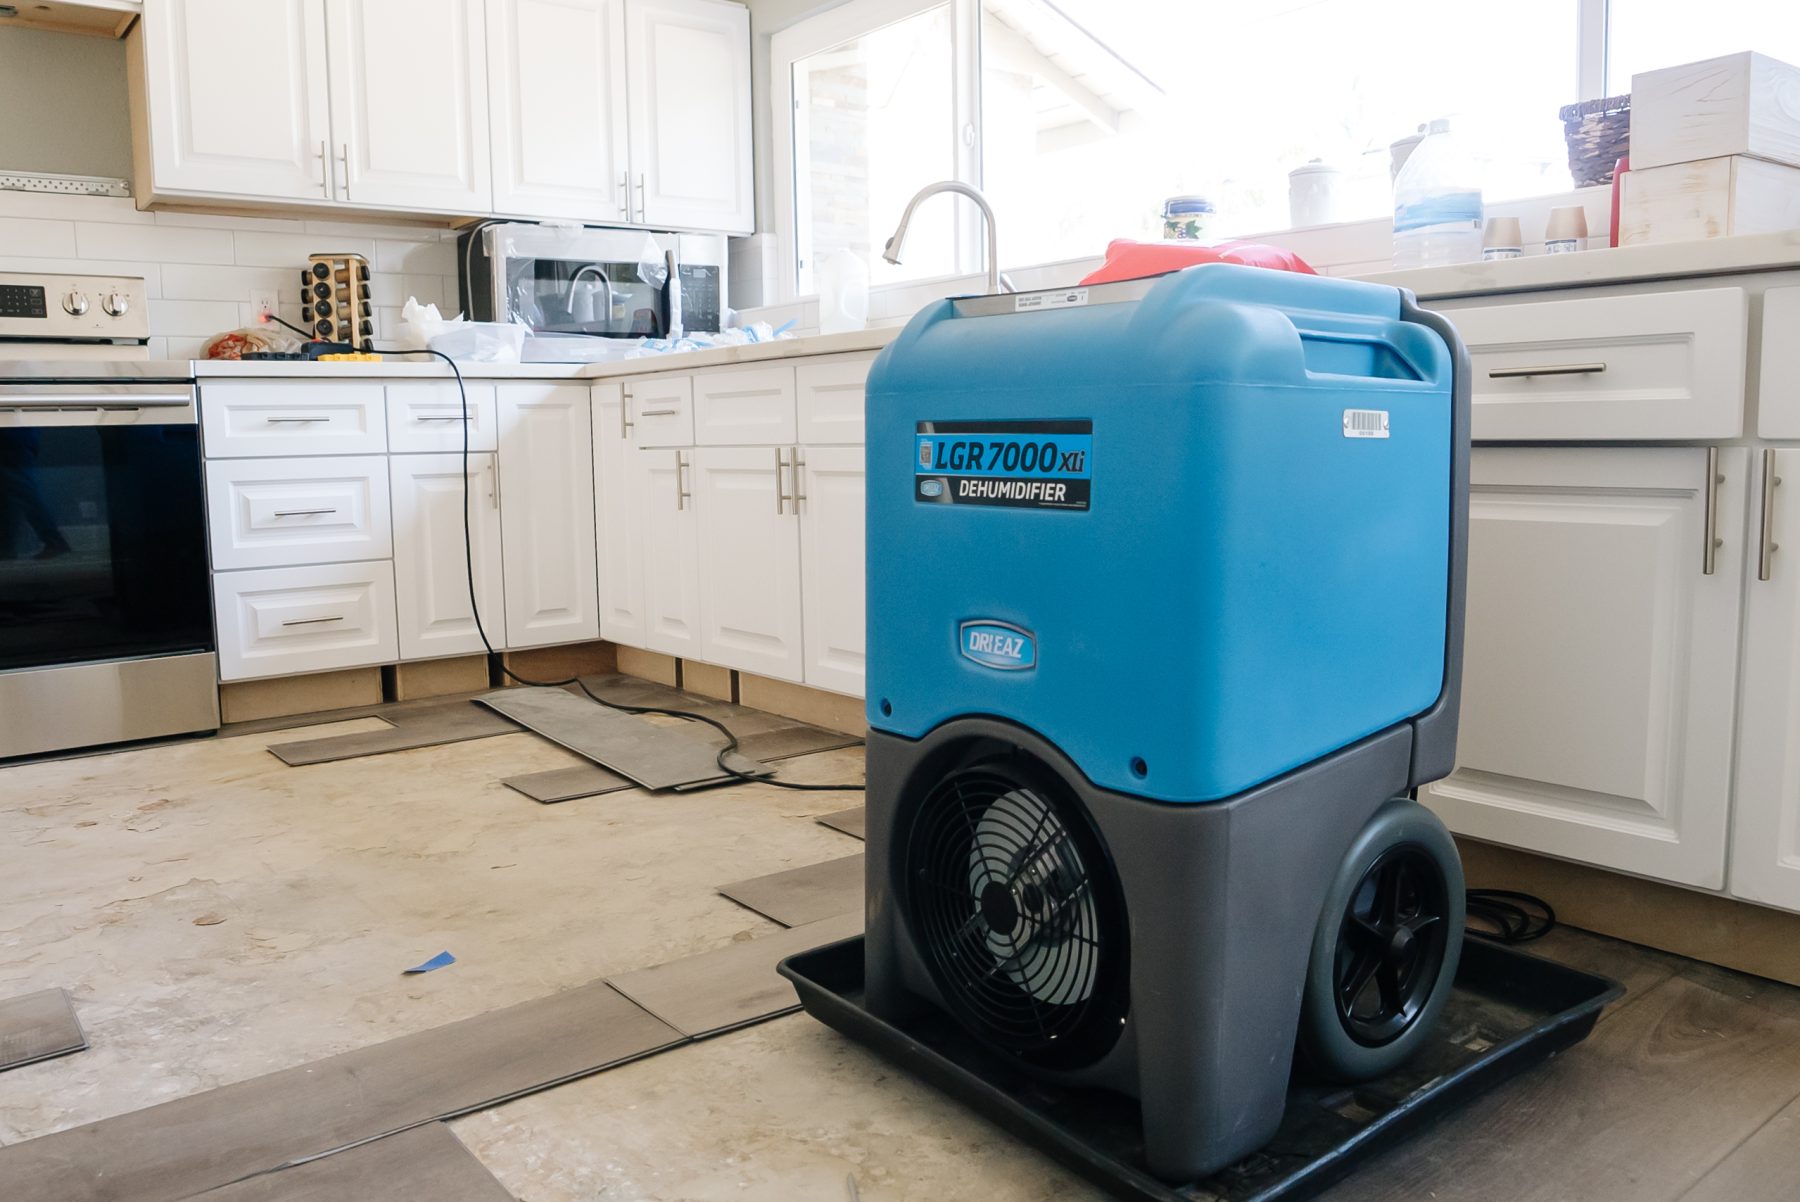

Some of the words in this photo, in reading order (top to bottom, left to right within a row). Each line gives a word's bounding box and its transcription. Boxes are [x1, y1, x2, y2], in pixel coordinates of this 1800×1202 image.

[935, 441, 984, 470] LGR
[987, 441, 1058, 473] 7000
[959, 479, 1067, 502] DEHUMIDIFIER
